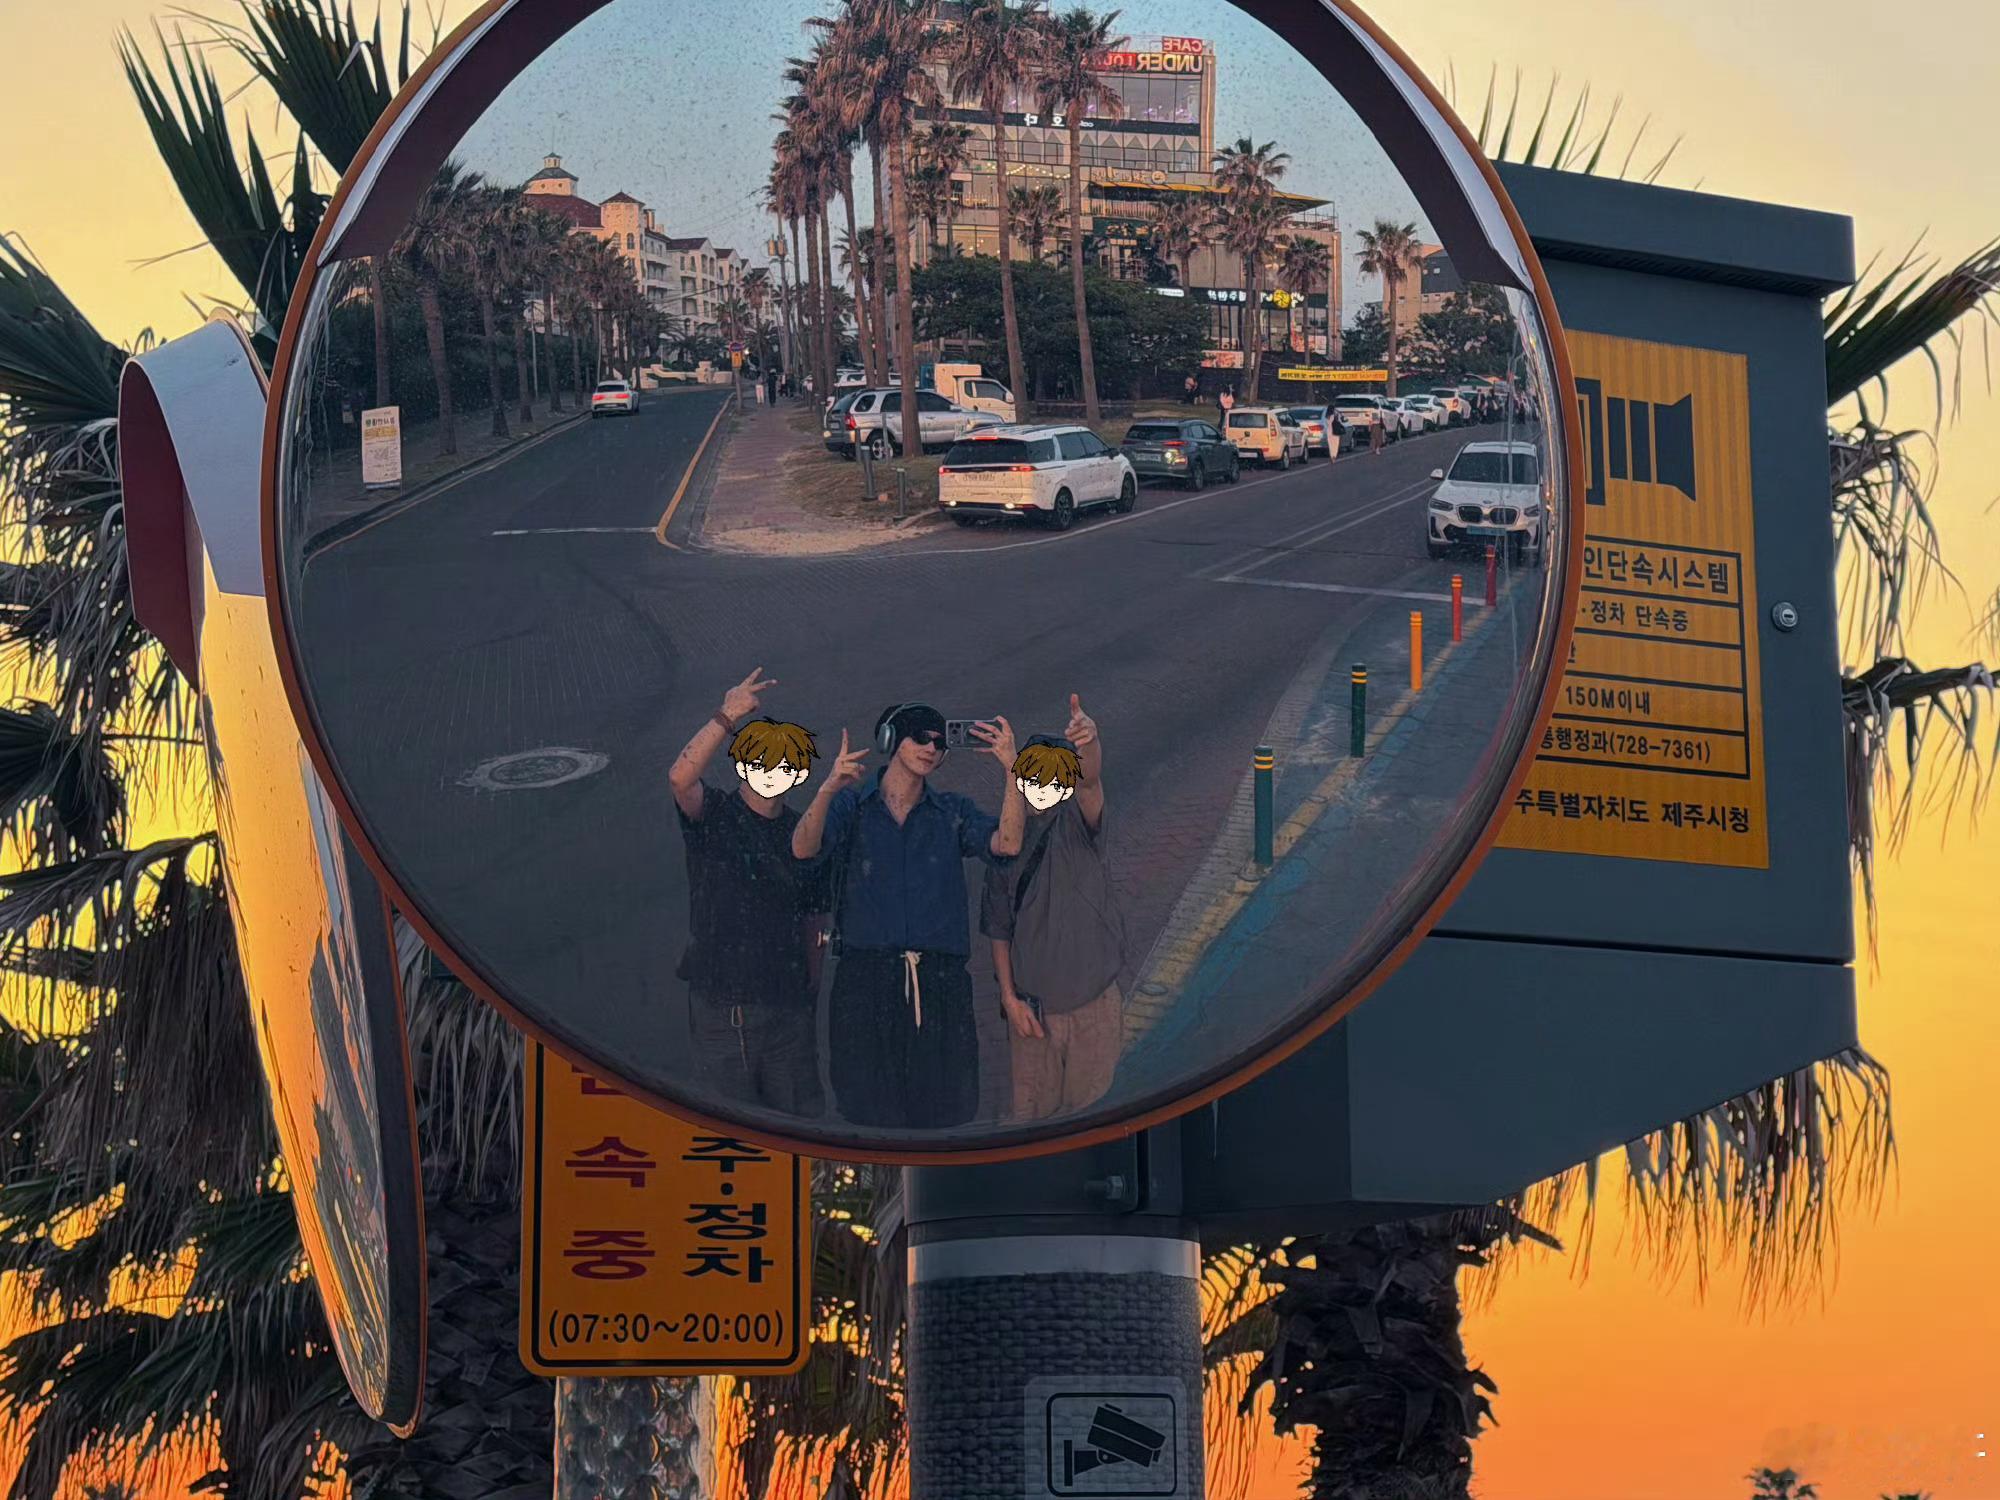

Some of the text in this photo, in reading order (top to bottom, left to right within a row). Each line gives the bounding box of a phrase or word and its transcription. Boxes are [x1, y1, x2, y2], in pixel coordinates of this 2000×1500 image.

[1584, 546, 1729, 595] 인단속시스템
[1635, 604, 1689, 632] 단속중
[1565, 685, 1651, 715] 150M이내
[1514, 788, 1750, 834] 주특별자치도 제주시청
[549, 1309, 784, 1348] (07:30~20:00)
